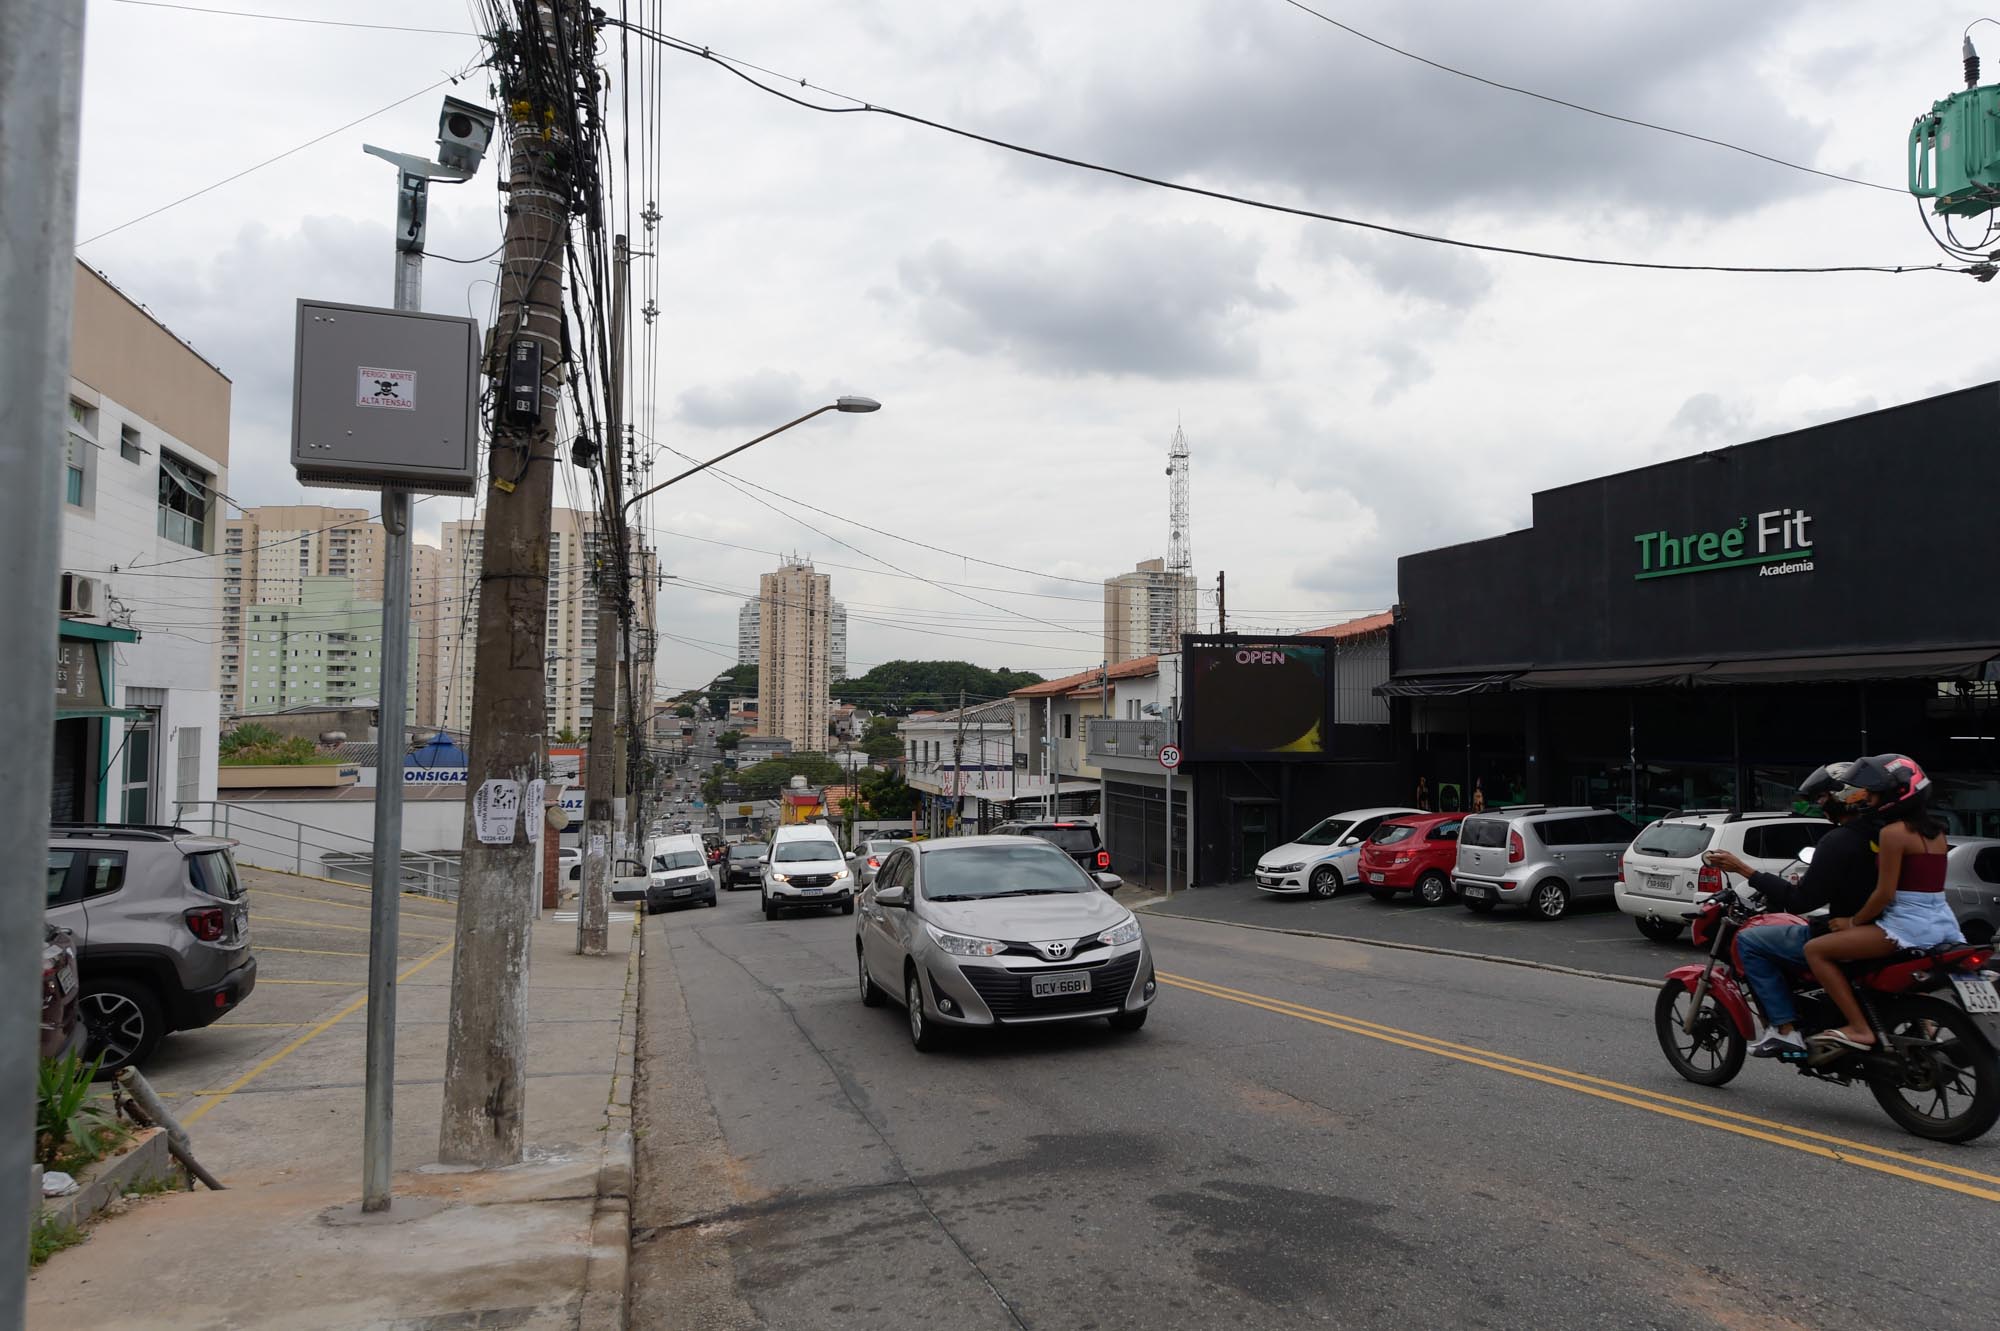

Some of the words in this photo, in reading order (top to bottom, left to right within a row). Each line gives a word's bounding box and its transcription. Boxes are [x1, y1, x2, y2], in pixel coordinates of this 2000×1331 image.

[390, 372, 413, 382] MORTE
[361, 396, 380, 405] ALTA
[1758, 508, 1814, 553] Fit
[1759, 559, 1814, 577] Academia
[57, 647, 70, 665] UE
[1235, 650, 1285, 665] OPEN
[1163, 750, 1178, 761] 50
[404, 770, 468, 782] ONSIGAZ
